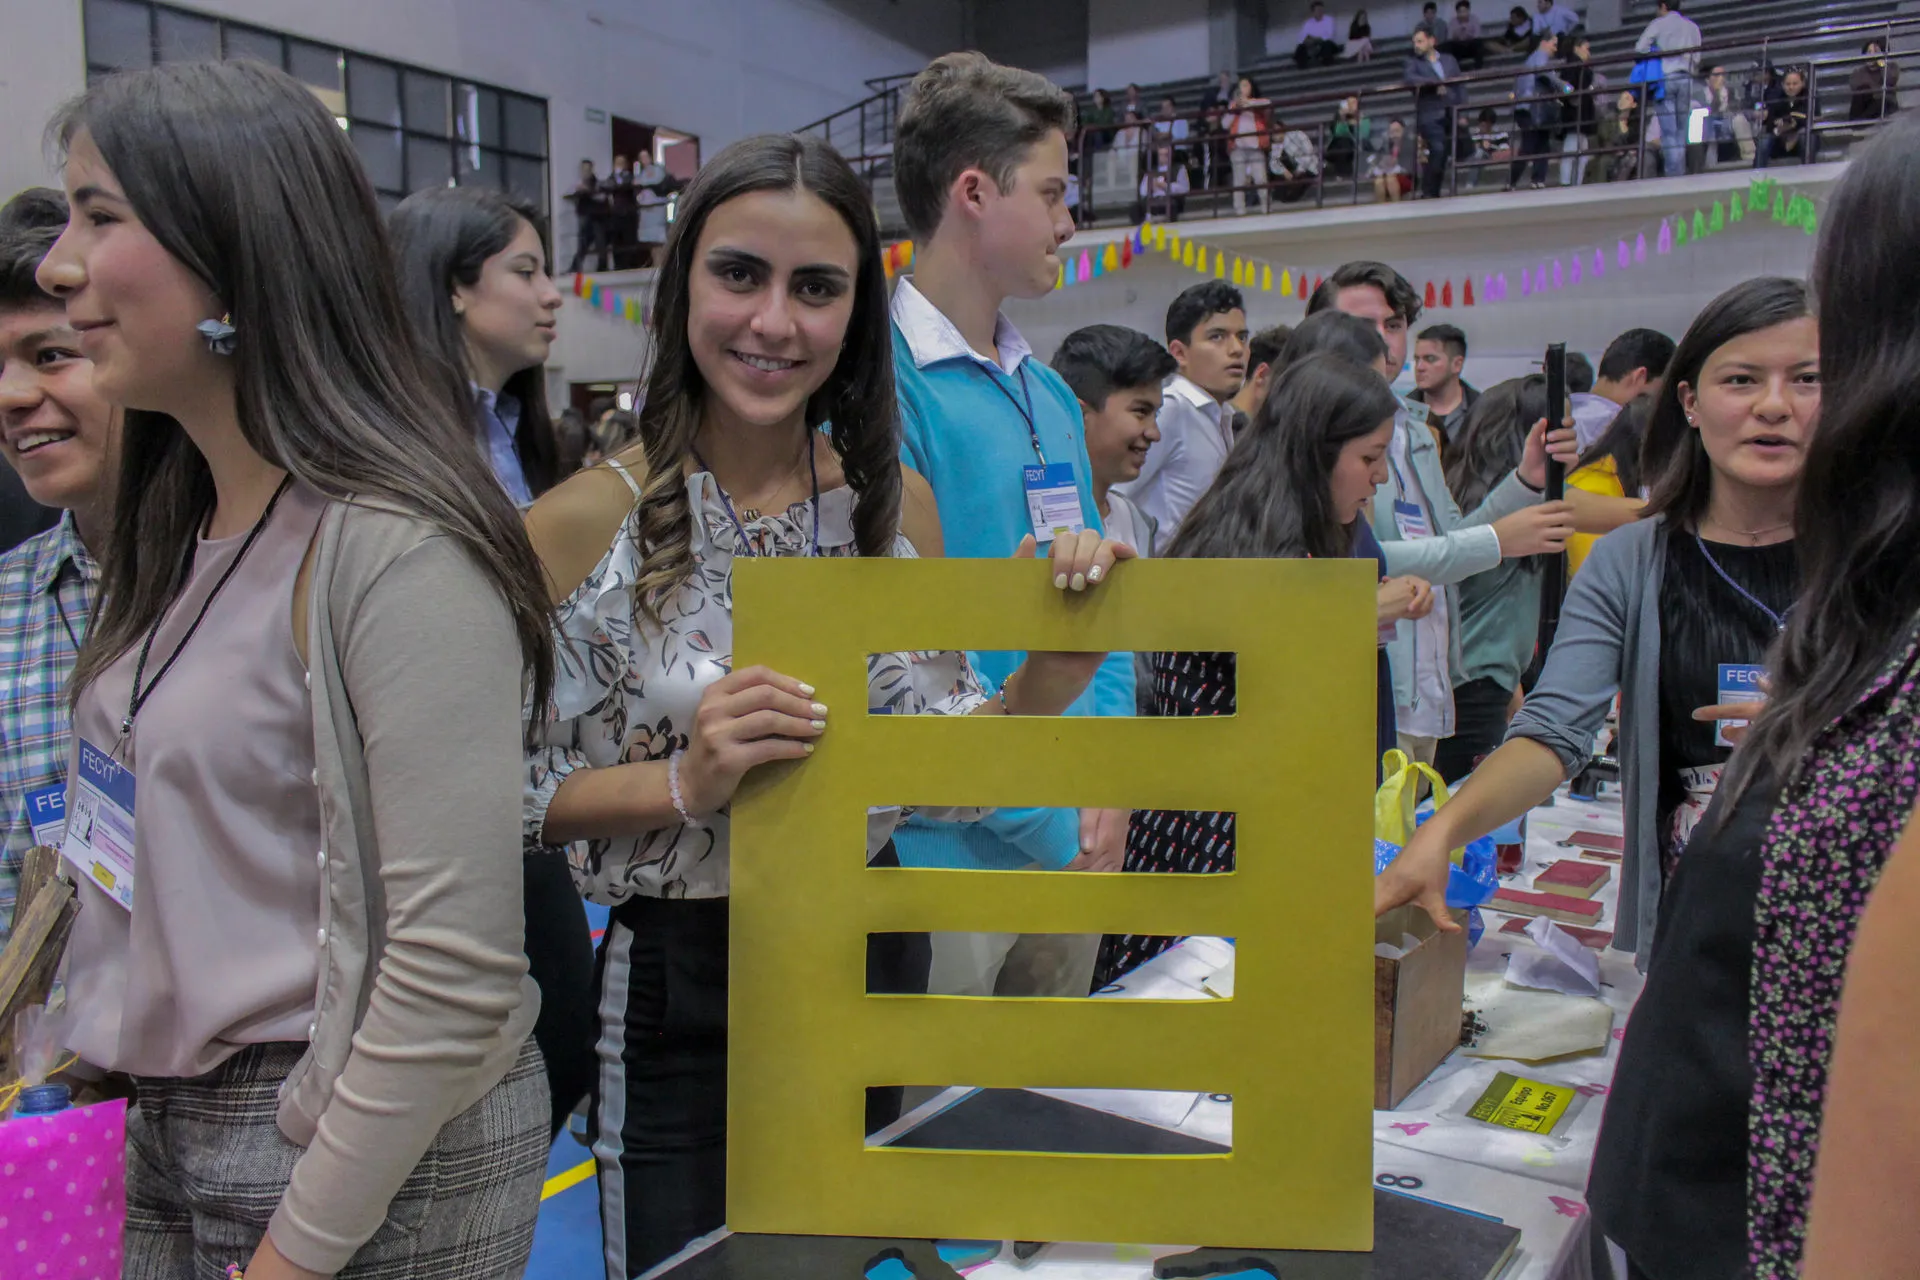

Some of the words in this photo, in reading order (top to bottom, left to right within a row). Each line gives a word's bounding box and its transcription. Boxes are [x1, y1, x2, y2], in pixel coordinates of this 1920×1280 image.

[1025, 469, 1045, 481] FECYT
[81, 747, 116, 783] FECYT
[35, 791, 67, 813] FE
[1509, 1086, 1533, 1106] Equipo
